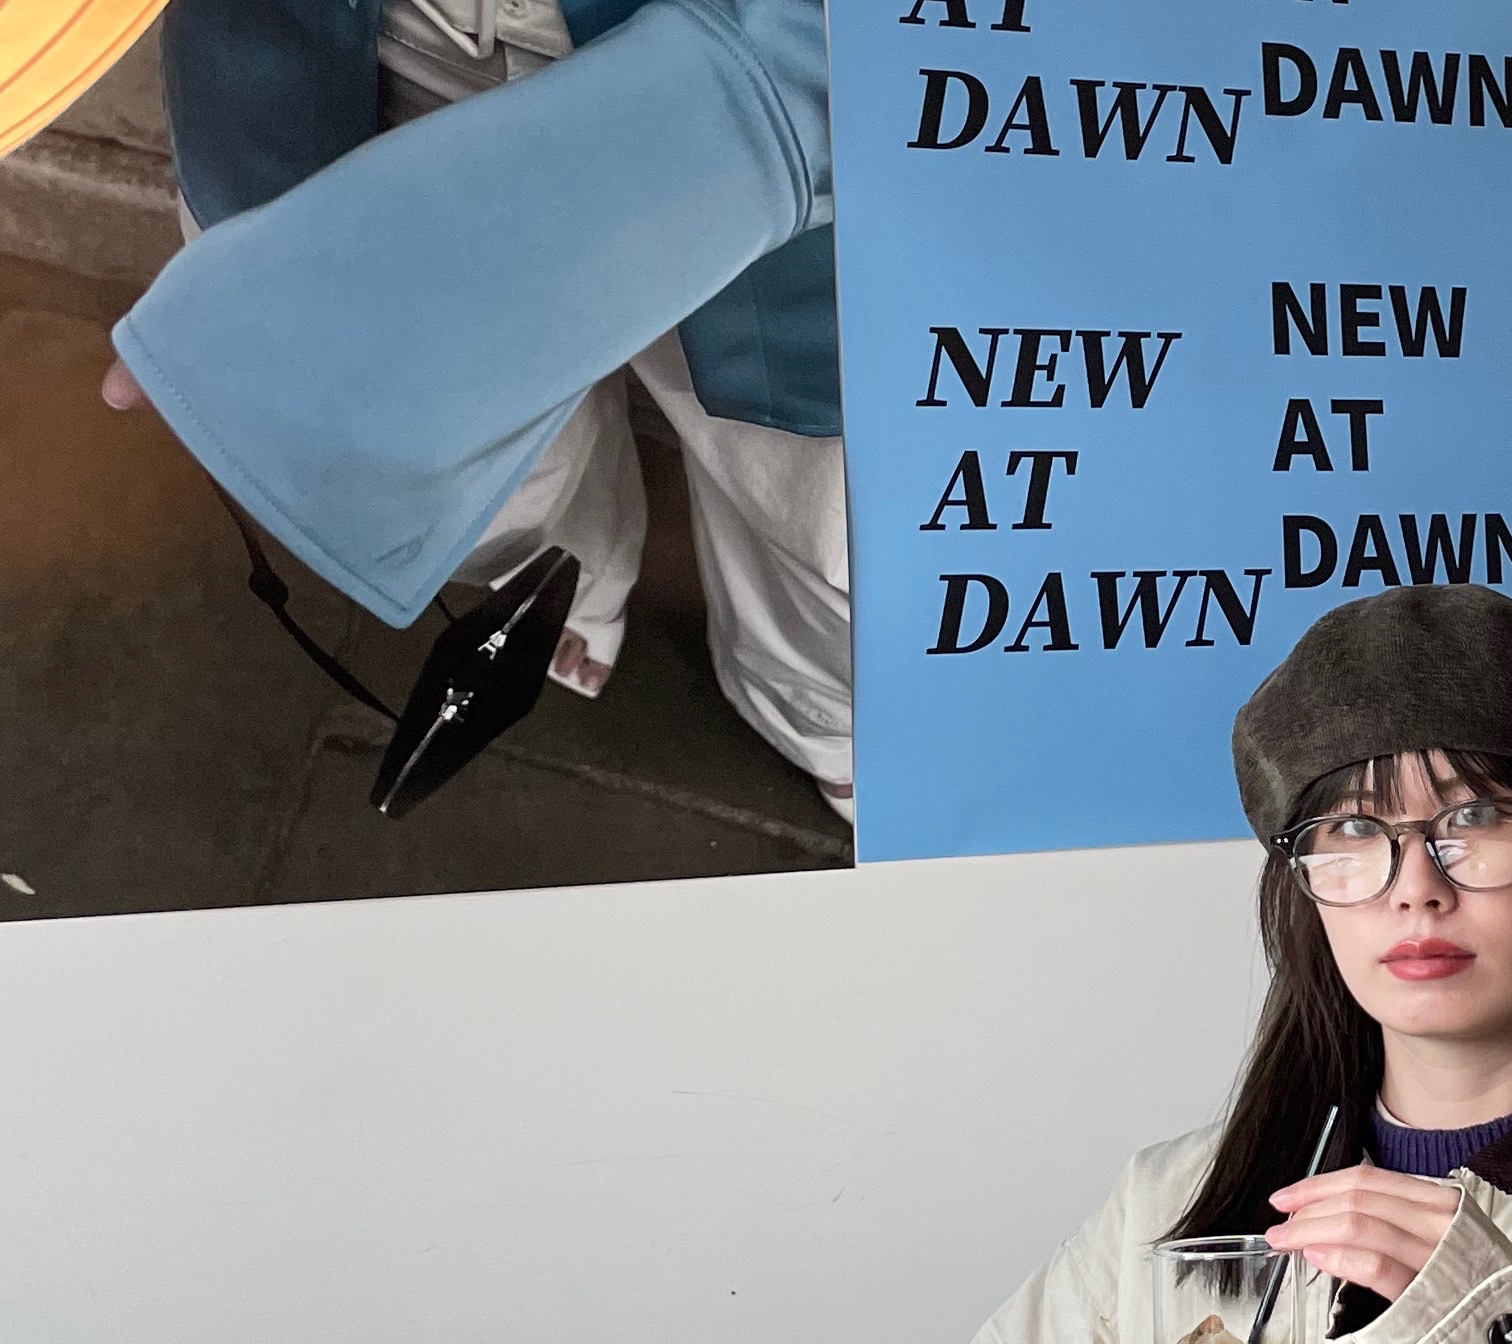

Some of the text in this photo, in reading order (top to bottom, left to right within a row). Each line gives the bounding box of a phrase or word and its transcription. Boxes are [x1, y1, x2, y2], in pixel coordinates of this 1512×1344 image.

[907, 68, 1252, 165] DAWN
[1271, 281, 1468, 359] NEW
[916, 326, 1182, 409] NEW
[1271, 398, 1385, 472] AT
[919, 450, 1079, 531] AT
[926, 568, 1273, 655] DAWN
